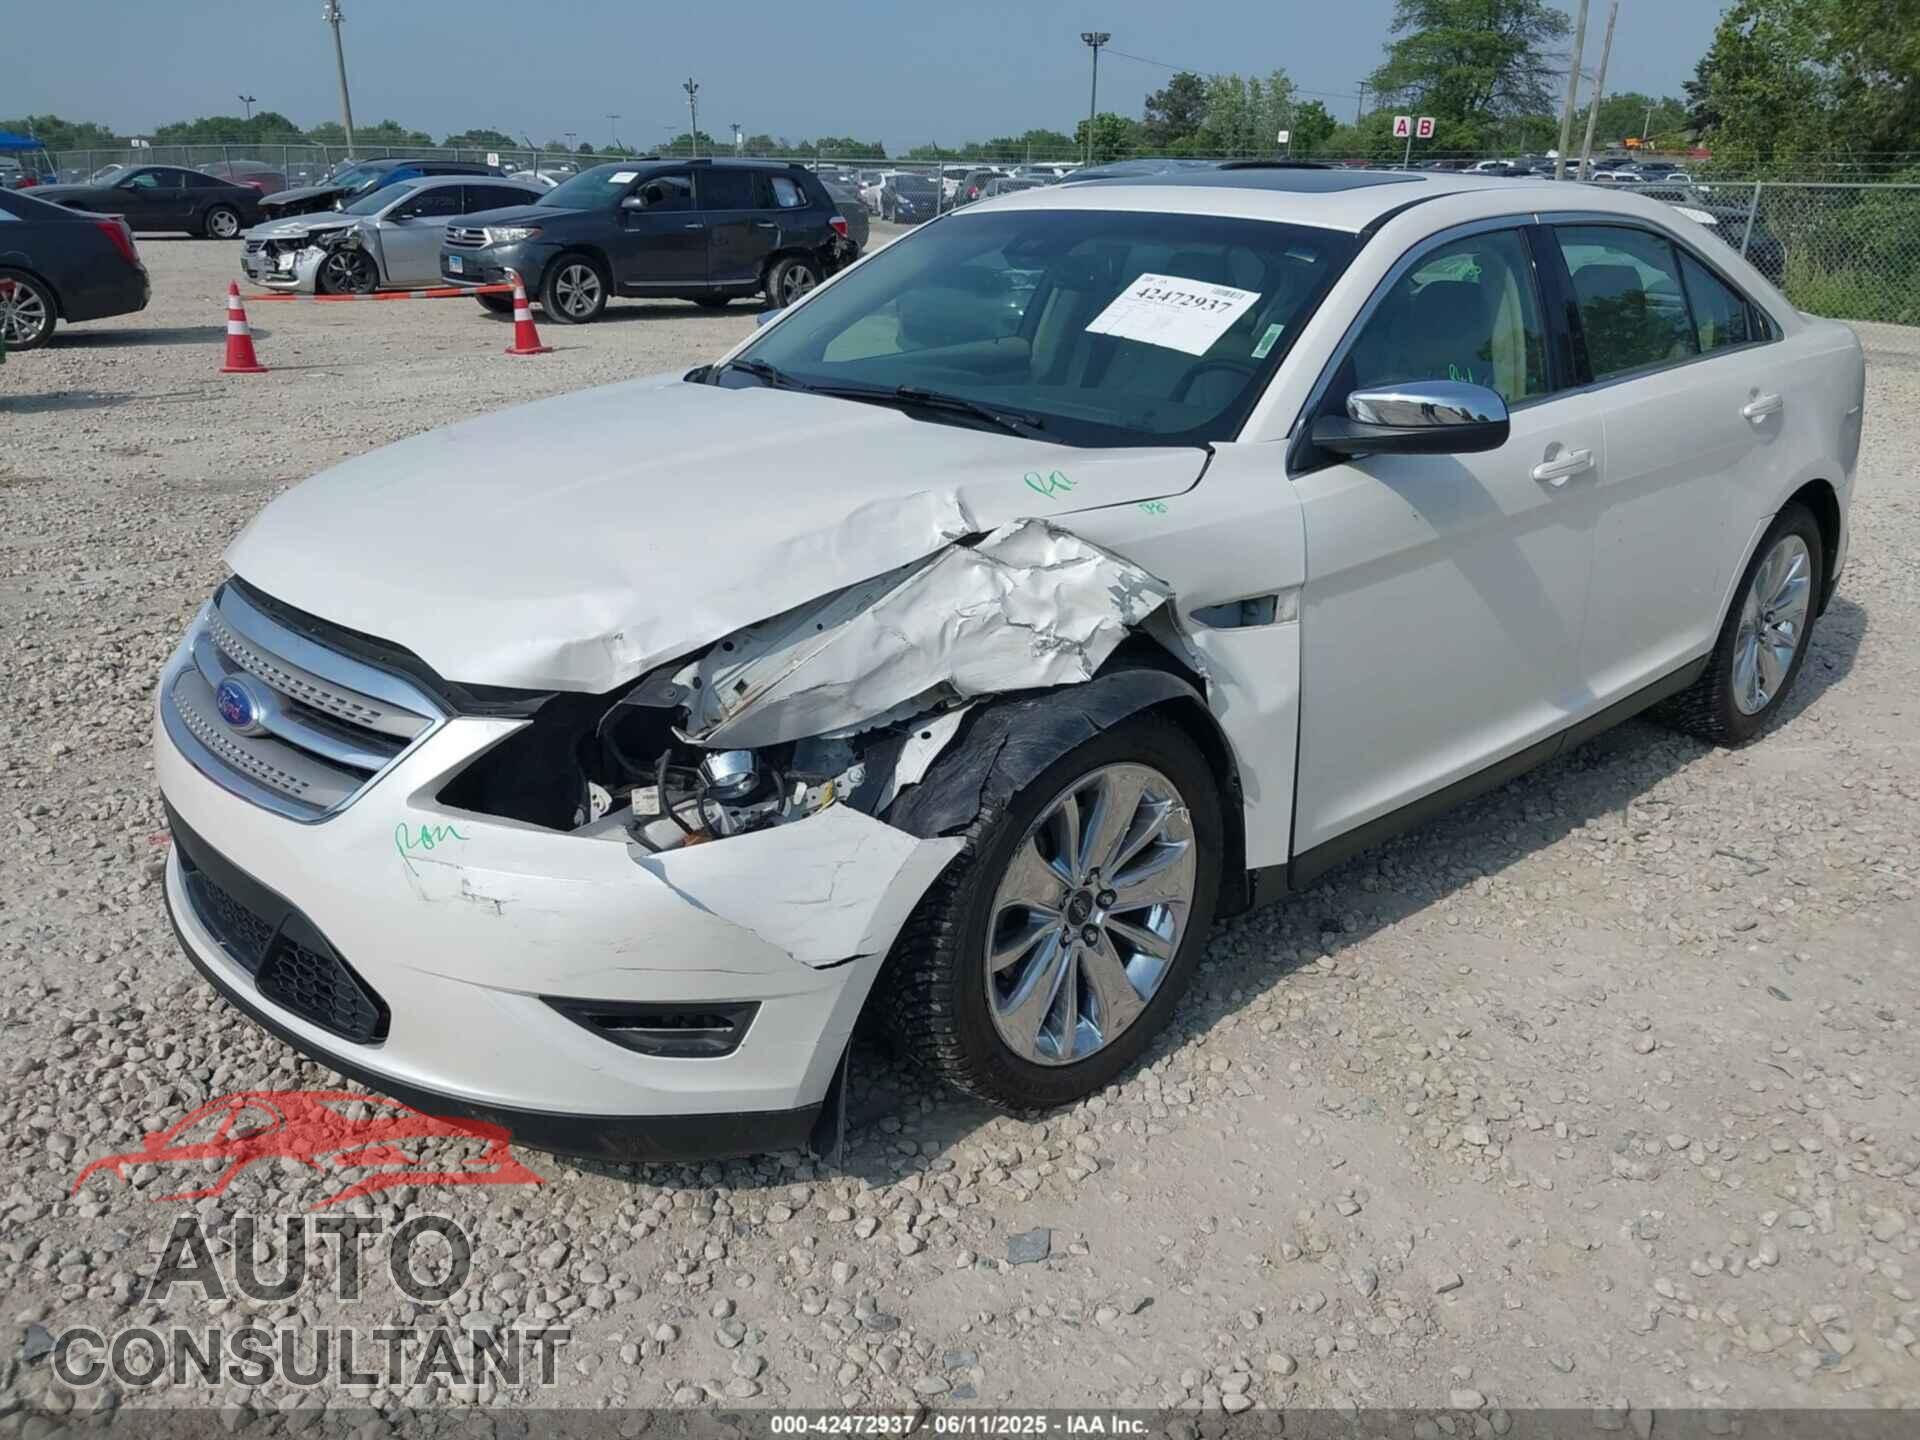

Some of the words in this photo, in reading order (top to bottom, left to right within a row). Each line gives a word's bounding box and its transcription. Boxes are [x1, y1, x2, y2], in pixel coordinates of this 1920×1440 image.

[1396, 119, 1407, 135] A
[1420, 120, 1431, 136] B
[1136, 287, 1233, 314] 42472937
